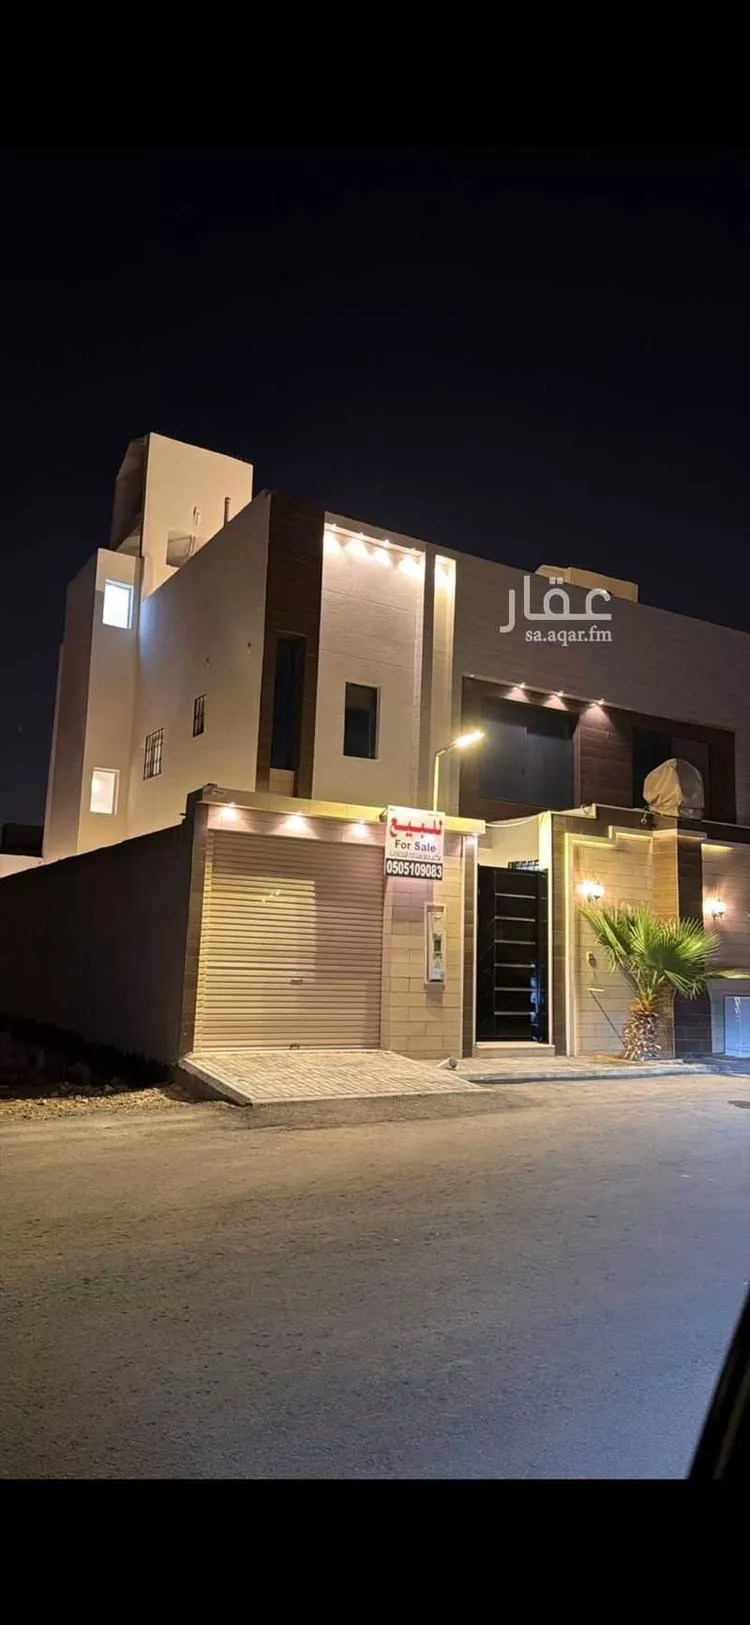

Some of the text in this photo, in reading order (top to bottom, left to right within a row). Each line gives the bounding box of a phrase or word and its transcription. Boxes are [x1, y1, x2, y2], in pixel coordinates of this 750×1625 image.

[390, 818, 443, 838] للبيع
[395, 839, 436, 852] For Sale
[386, 860, 442, 878] 0505109083
